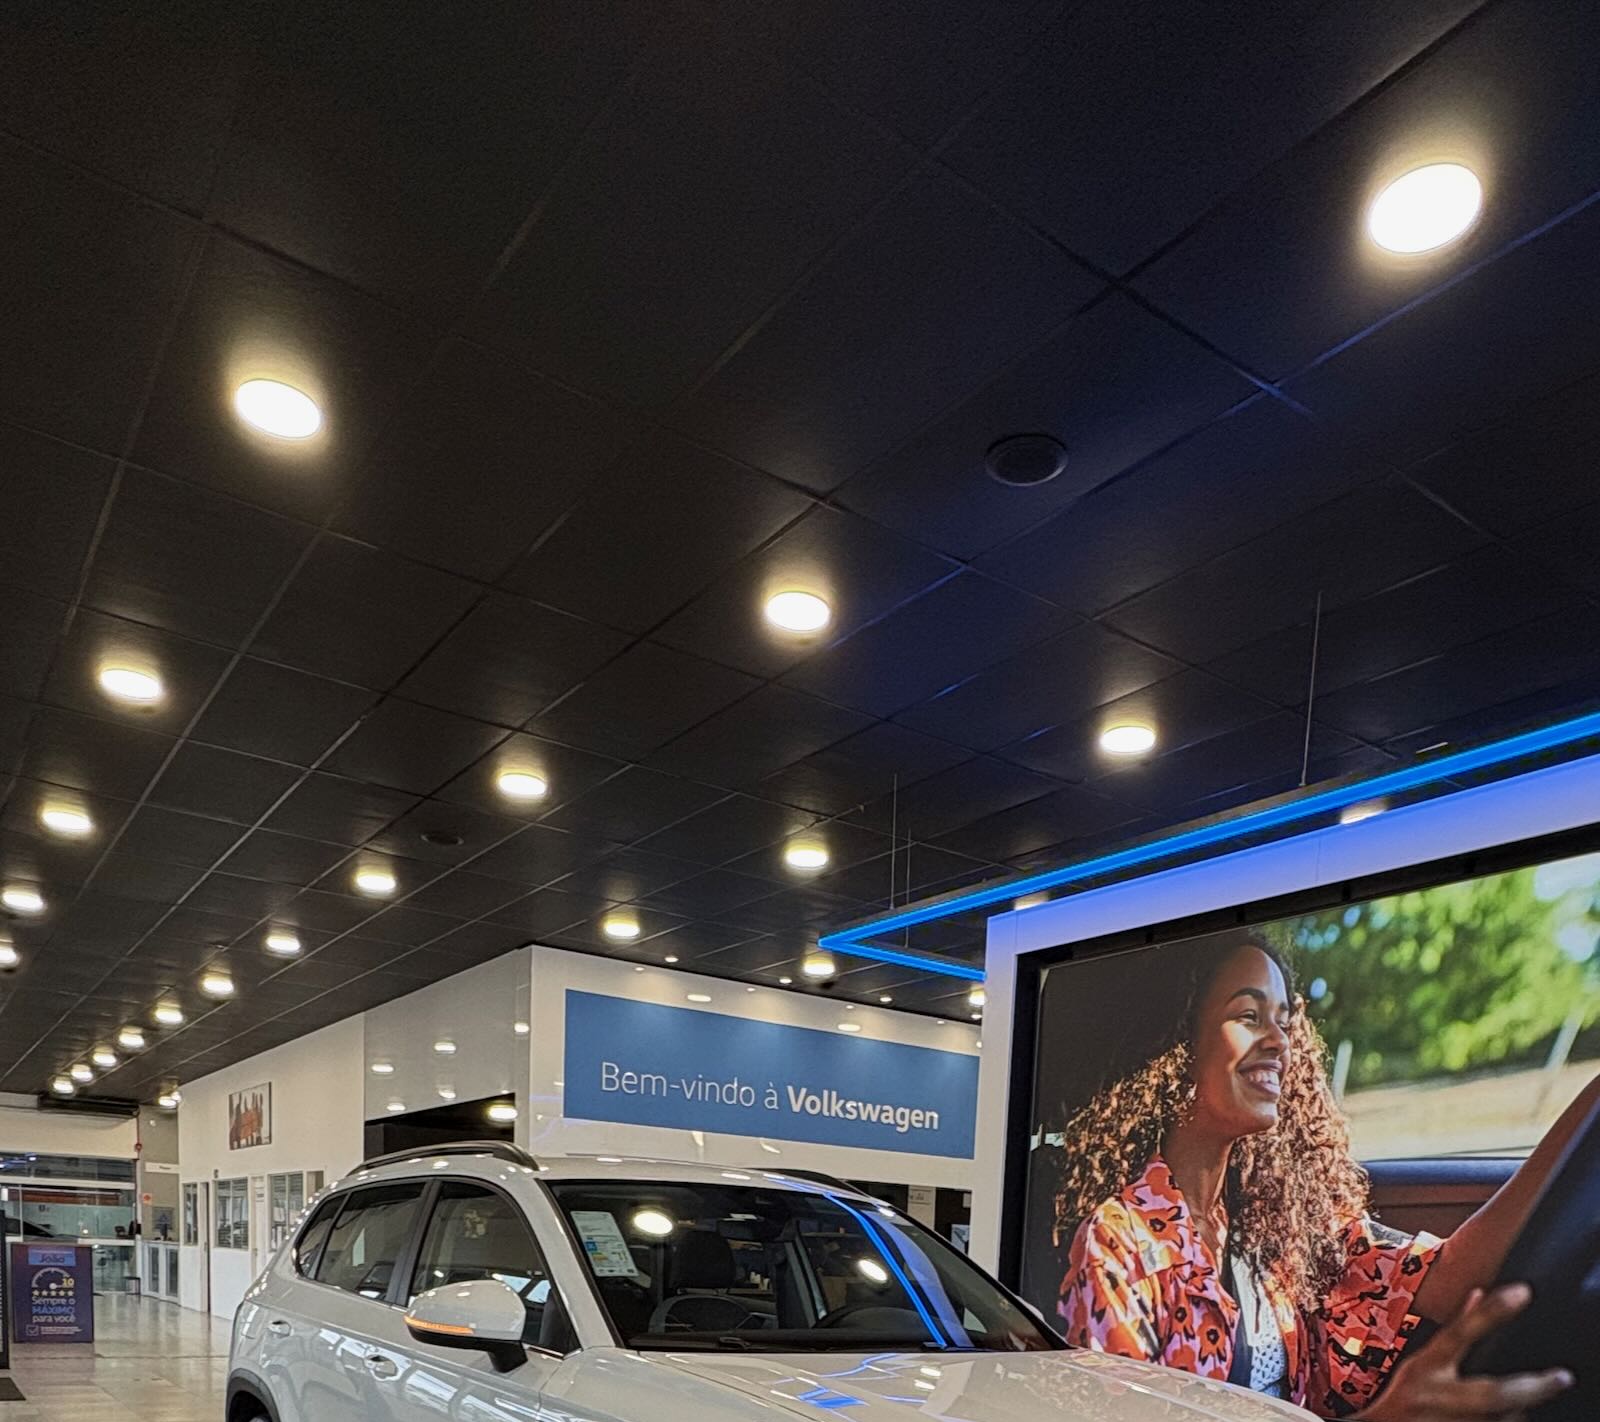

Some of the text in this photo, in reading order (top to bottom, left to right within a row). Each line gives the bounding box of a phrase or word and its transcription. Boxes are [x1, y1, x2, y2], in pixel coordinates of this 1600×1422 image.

[600, 1061, 940, 1133] Bem-vindo à Volkswagen
[62, 1278, 75, 1287] 10
[32, 1296, 67, 1305] Sempre
[32, 1304, 75, 1314] MÁXIMO
[32, 1313, 76, 1323] para você
